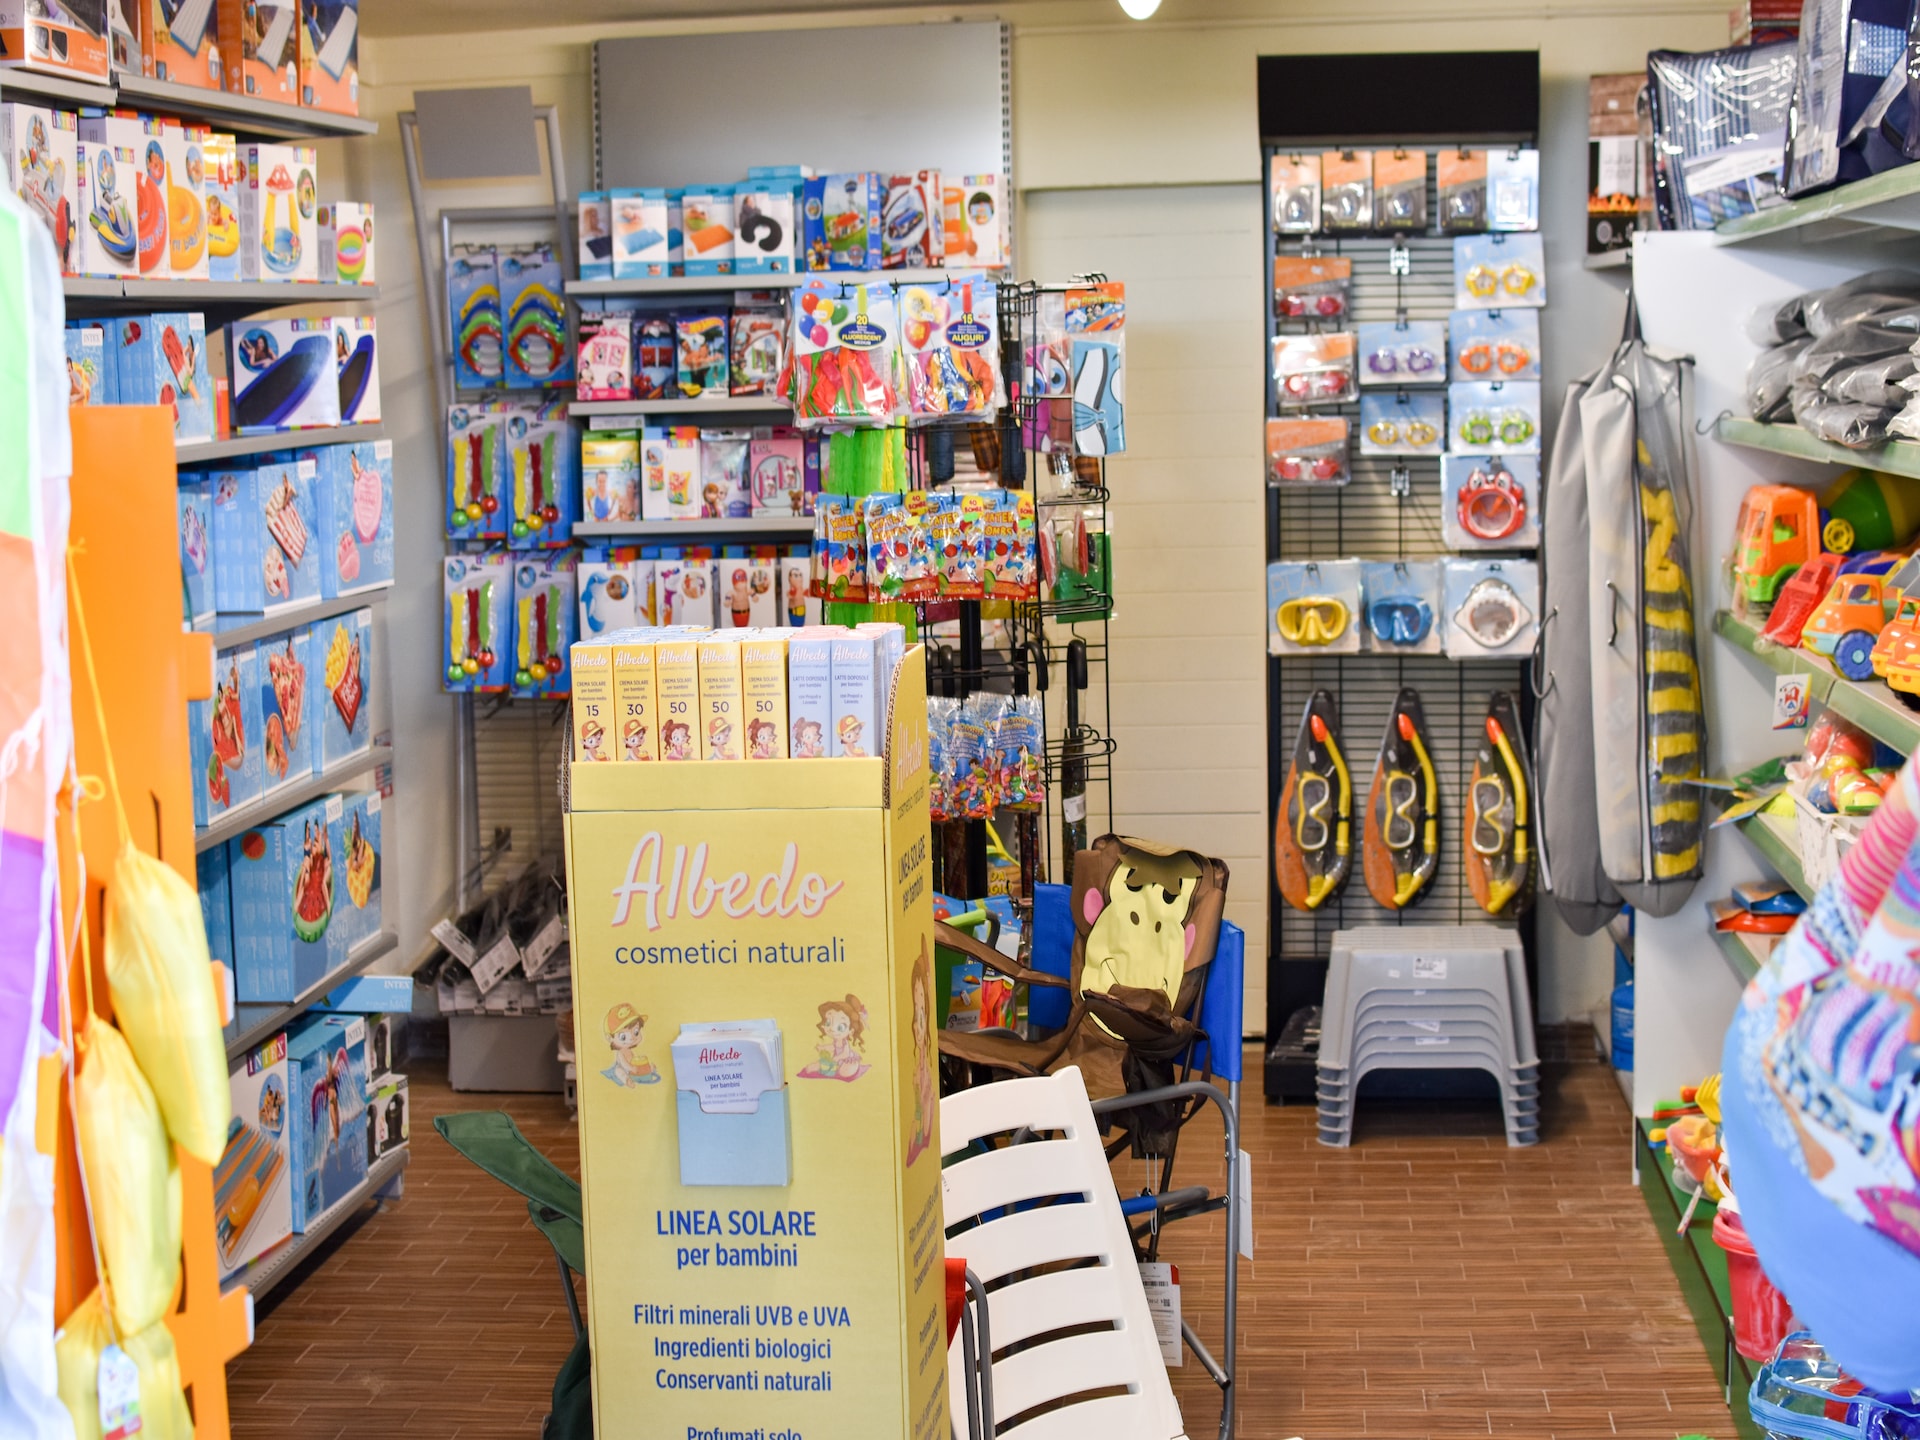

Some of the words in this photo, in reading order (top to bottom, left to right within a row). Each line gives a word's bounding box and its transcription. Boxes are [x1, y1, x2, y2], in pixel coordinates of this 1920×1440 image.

[856, 314, 868, 325] 20
[962, 313, 973, 325] 15
[841, 333, 881, 342] FLUORESCENT
[952, 334, 984, 342] AUGURI
[932, 527, 960, 540] OMBS
[984, 525, 1013, 537] OMBS
[573, 652, 608, 668] Albedo
[615, 650, 650, 667] Albedo
[658, 648, 694, 666] Albedo
[700, 647, 737, 664] Albedo
[744, 647, 781, 665] Albedo
[791, 647, 827, 663] Albedo
[833, 645, 869, 662] Albedo
[586, 704, 599, 717] 15
[626, 703, 644, 716] 30
[670, 701, 687, 713] 50
[712, 701, 730, 713] 50
[756, 700, 774, 713] 50
[611, 831, 844, 932] Albedo
[615, 939, 738, 965] cosmetici
[748, 936, 845, 964] naturali
[384, 979, 411, 990] INTEX
[248, 1039, 287, 1076] INTEX
[699, 1047, 742, 1065] Albedo
[720, 1081, 740, 1089] bambini
[722, 1073, 743, 1081] SOLARE
[656, 1210, 722, 1236] LINEA
[728, 1210, 817, 1237] SOLARE
[677, 1246, 710, 1270] per
[715, 1243, 798, 1267] bambini
[633, 1304, 674, 1326] Filtri
[679, 1305, 751, 1326] minerali
[755, 1306, 793, 1327] UVB
[798, 1311, 809, 1327] e
[813, 1307, 851, 1328] UVA
[654, 1337, 750, 1361] Ingredienti
[755, 1338, 832, 1363] biologici
[655, 1369, 759, 1391] Conservanti
[763, 1371, 832, 1392] naturali
[687, 1426, 764, 1440] Profumati
[768, 1428, 803, 1440] solo
